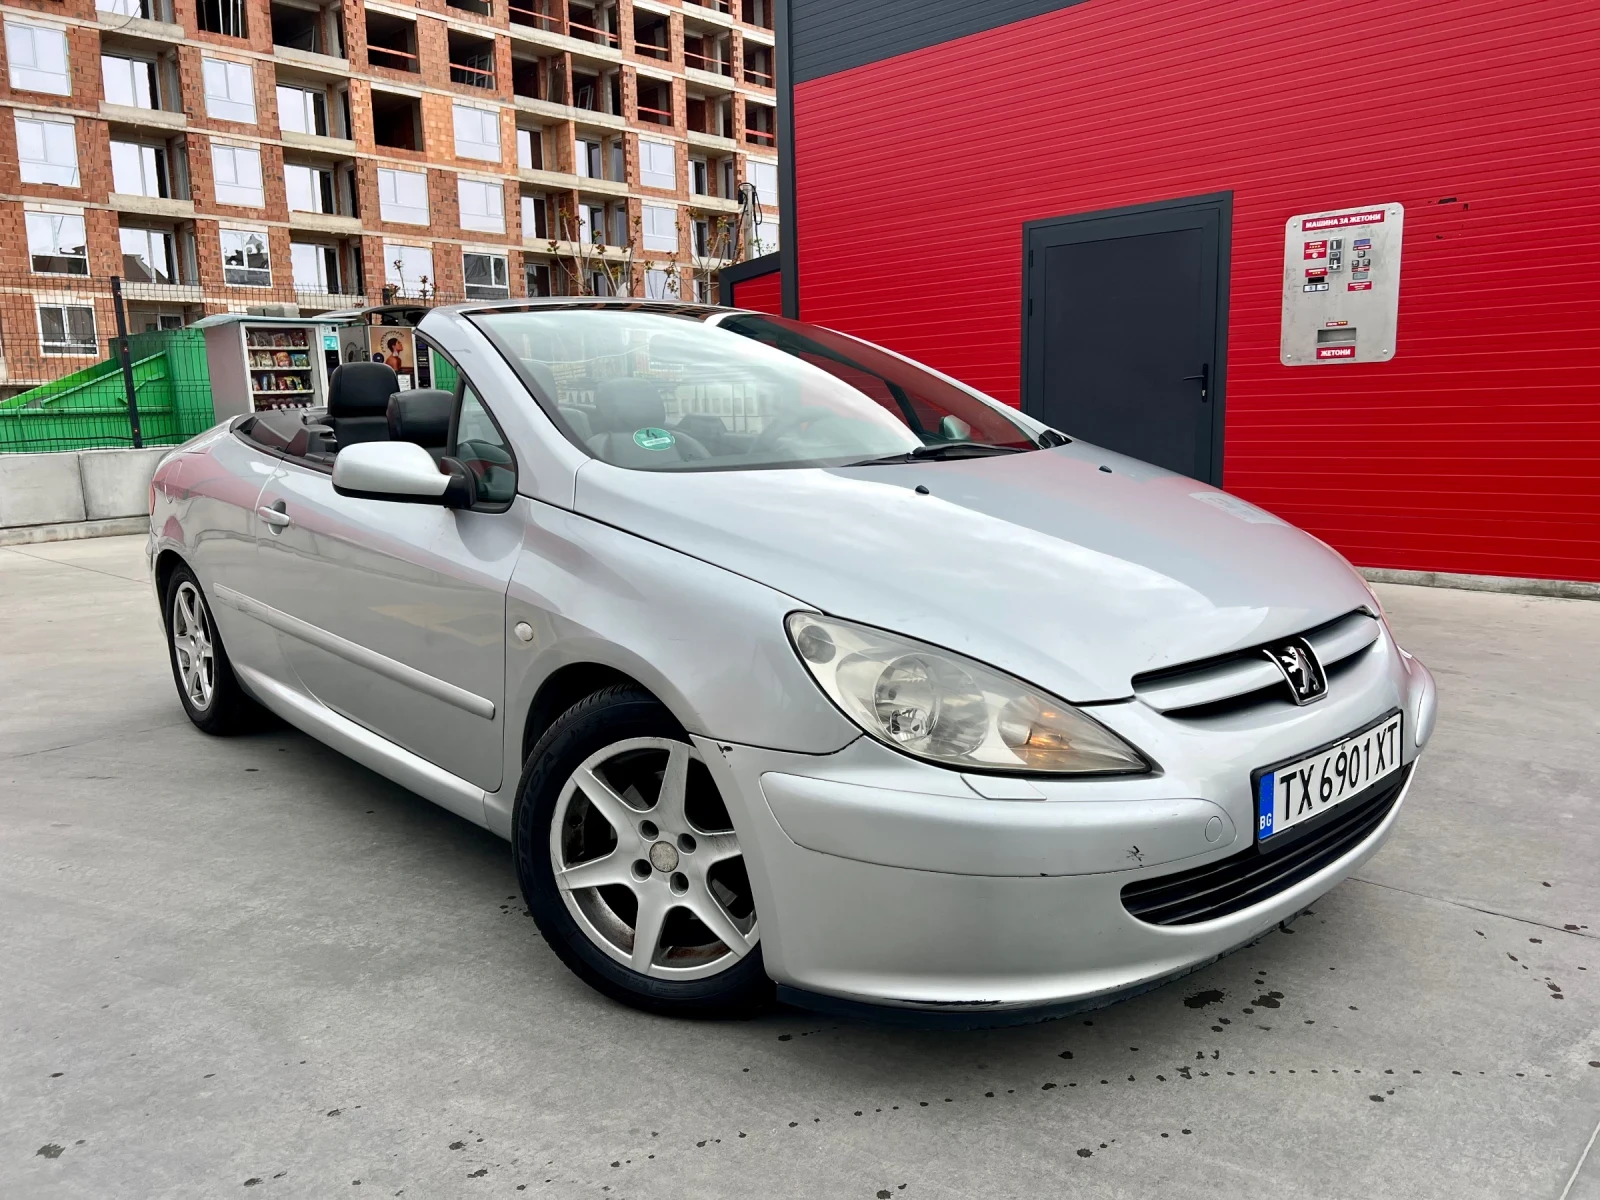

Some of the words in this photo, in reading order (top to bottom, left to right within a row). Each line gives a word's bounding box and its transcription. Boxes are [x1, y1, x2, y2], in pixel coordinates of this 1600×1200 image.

[1305, 219, 1338, 229] МАШИНА
[1339, 217, 1349, 225] ЗА
[1349, 213, 1381, 223] ЖЕТОНИ
[1320, 348, 1351, 357] ЖЕТОНИ
[1259, 813, 1272, 830] BG
